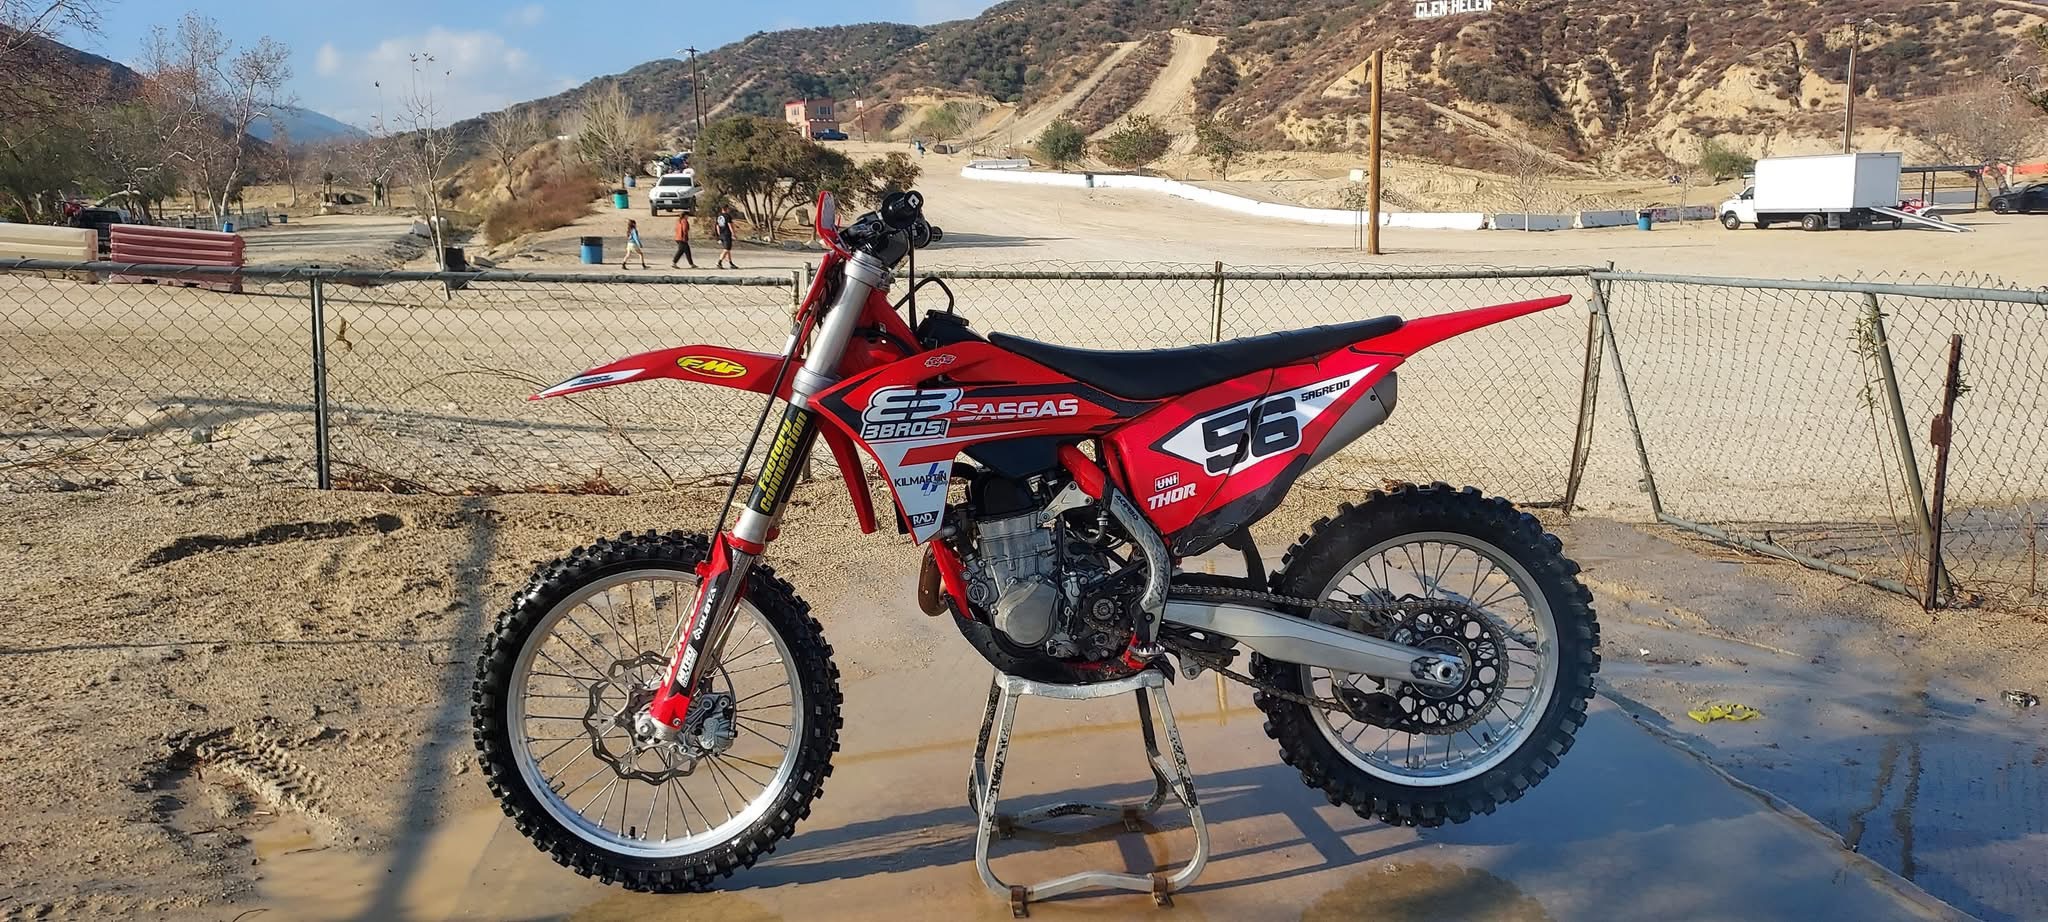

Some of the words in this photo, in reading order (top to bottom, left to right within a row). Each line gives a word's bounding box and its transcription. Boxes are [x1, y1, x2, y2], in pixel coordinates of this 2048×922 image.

[1416, 1, 1447, 18] GLEN
[1451, 0, 1492, 15] HELEN
[679, 356, 747, 375] FMF
[1301, 379, 1350, 402] SAGREDO
[863, 420, 941, 439] 3BROS
[1202, 396, 1300, 474] 56
[759, 418, 792, 492] Factory
[760, 411, 808, 513] Connection
[894, 472, 947, 488] KILMARTIN
[1156, 475, 1178, 489] UNI
[1148, 483, 1197, 510] THOR
